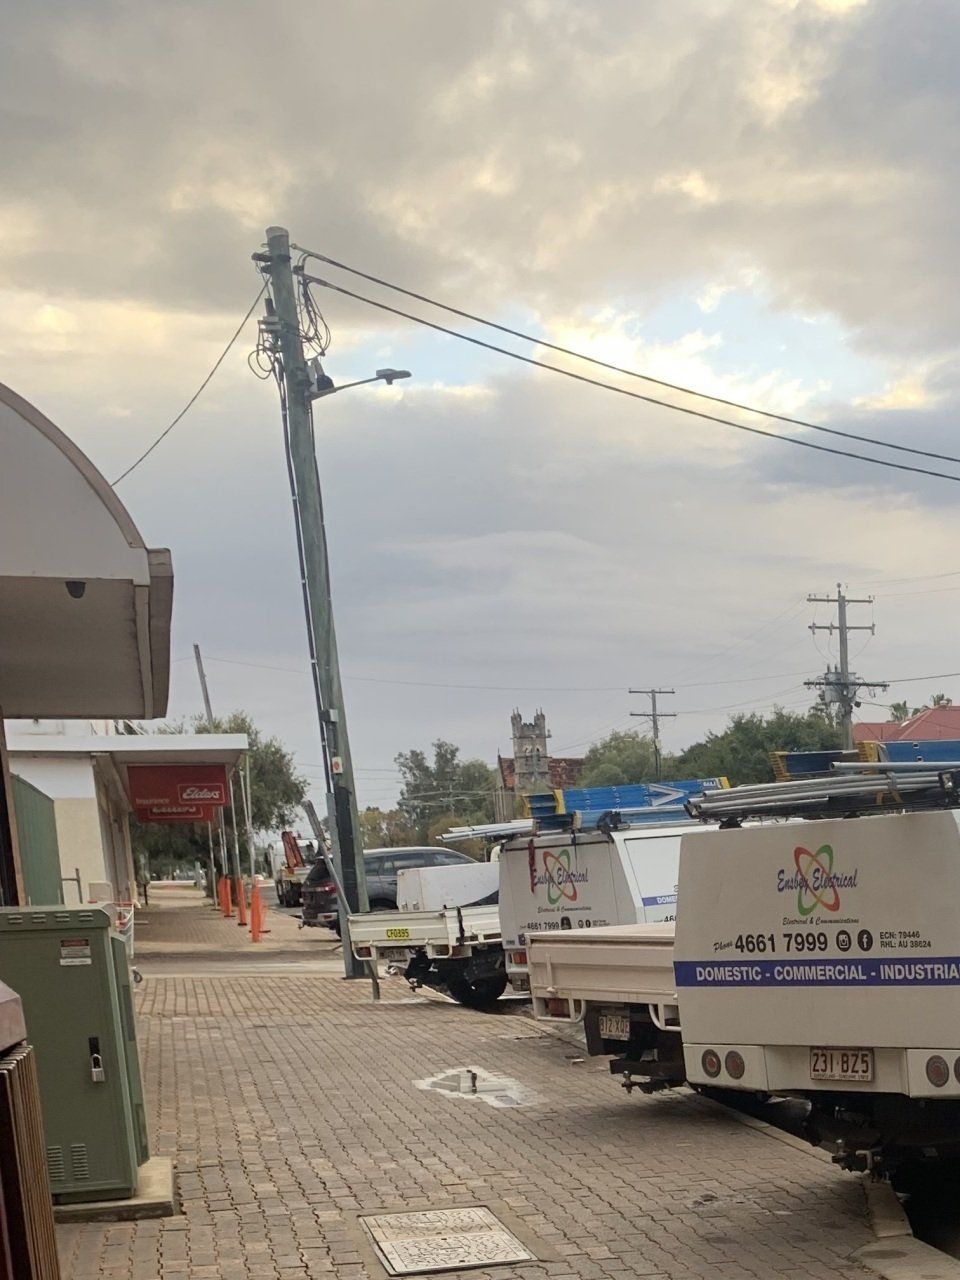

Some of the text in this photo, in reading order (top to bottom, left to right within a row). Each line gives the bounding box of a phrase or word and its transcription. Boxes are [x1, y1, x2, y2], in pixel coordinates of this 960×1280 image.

[182, 787, 220, 799] Elders
[812, 867, 858, 891] Electrical
[734, 933, 776, 953] 4661
[783, 932, 828, 952] 7999
[696, 967, 762, 981] DOMESTIC
[774, 965, 867, 981] COMMERCIAL
